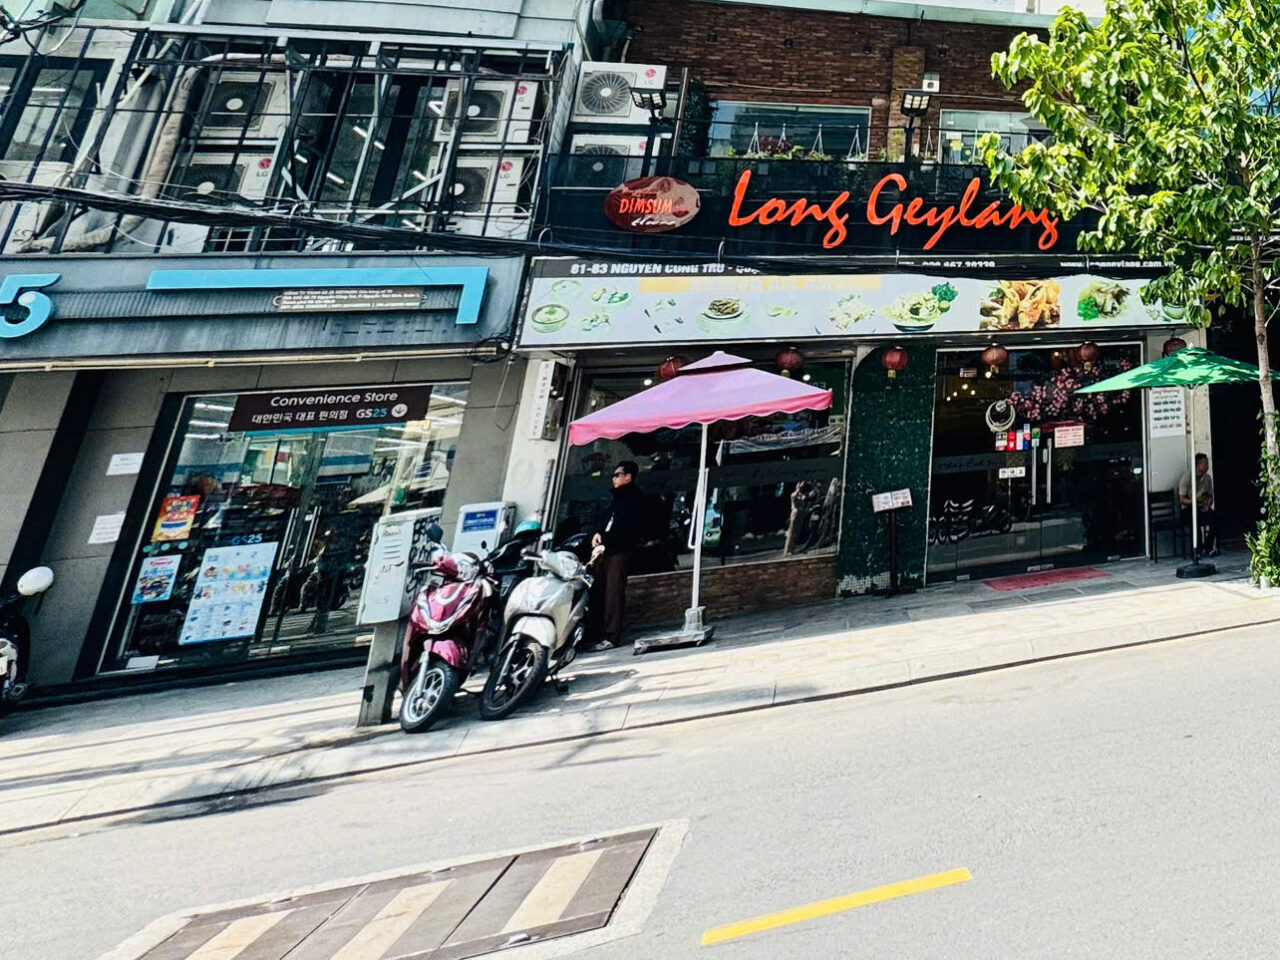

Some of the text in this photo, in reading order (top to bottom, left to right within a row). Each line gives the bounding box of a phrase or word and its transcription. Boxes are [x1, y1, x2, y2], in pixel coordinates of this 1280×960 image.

[618, 198, 672, 214] DIMSUM
[728, 169, 1059, 250] Long Geylang
[570, 263, 608, 274] 81-83
[270, 392, 398, 407] Convenience Store
[252, 408, 388, 424] 대한민국 대표 편의점 GS25
